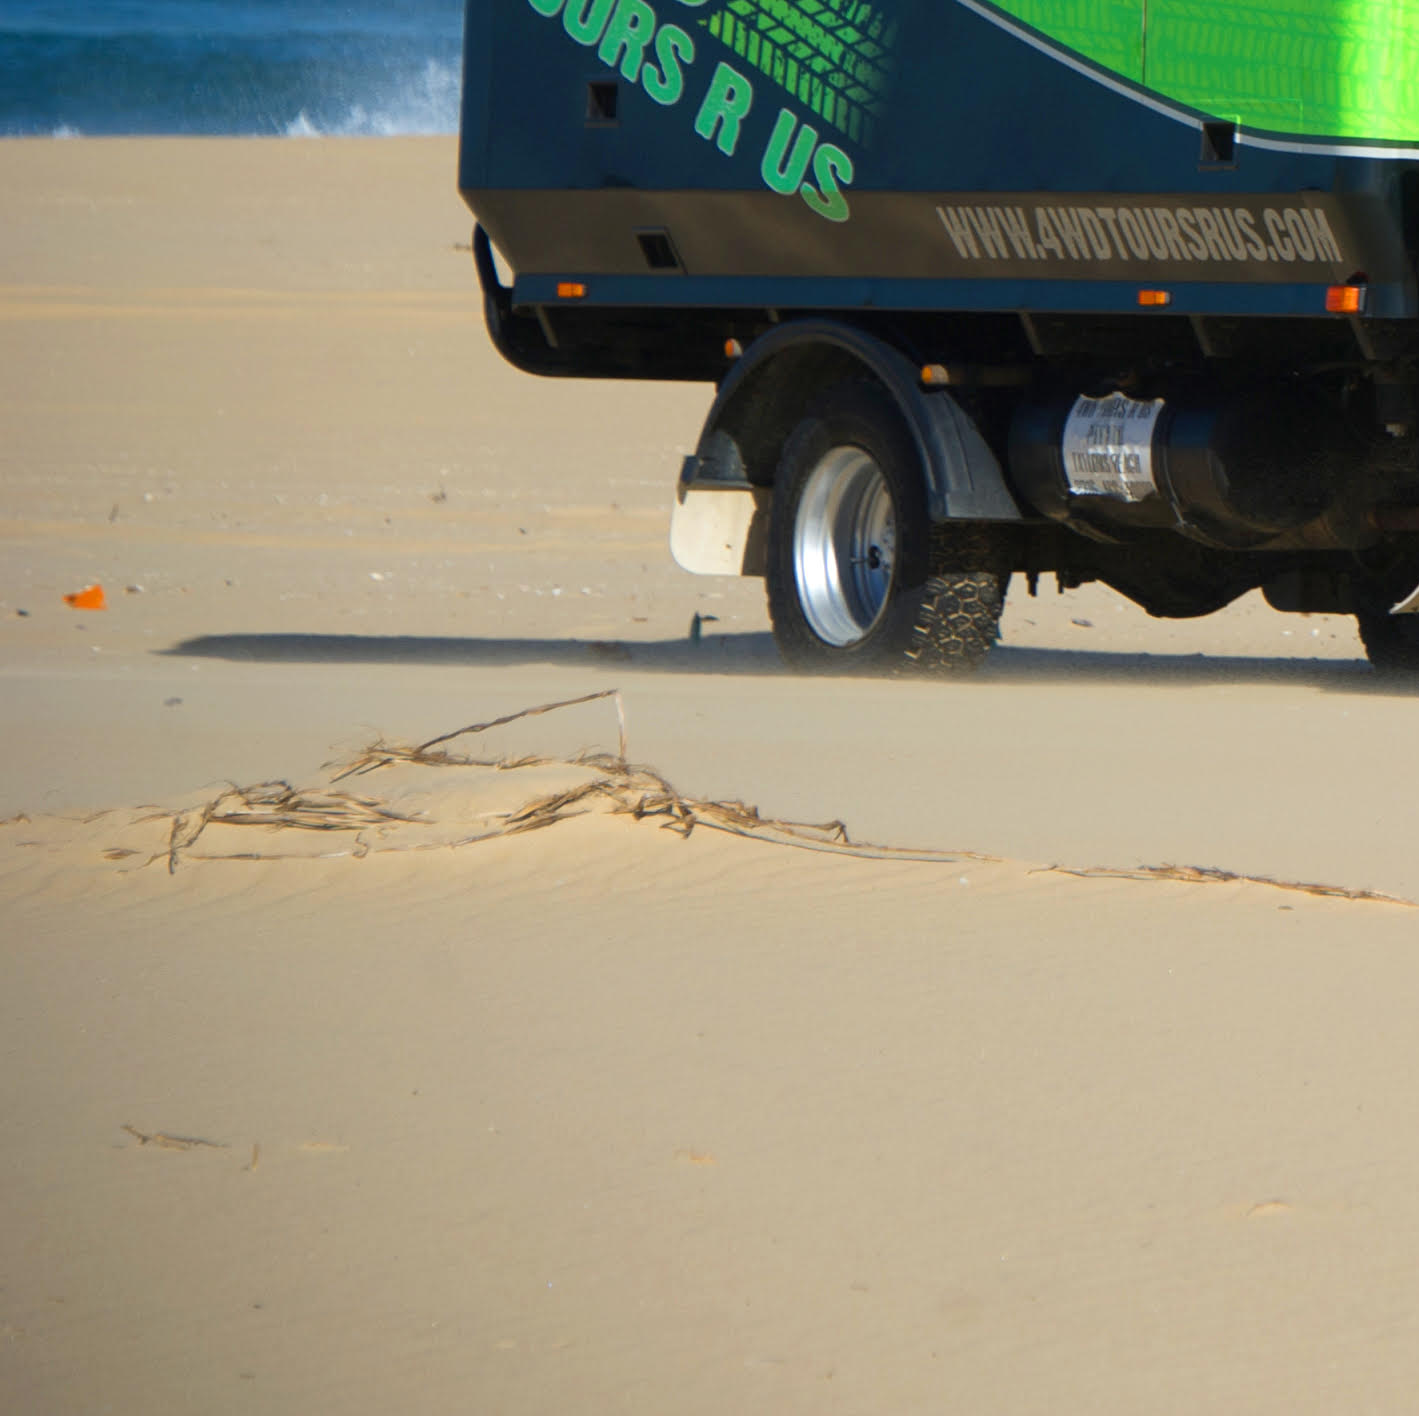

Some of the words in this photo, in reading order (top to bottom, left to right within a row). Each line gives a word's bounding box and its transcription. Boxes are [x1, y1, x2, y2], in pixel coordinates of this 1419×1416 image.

[694, 61, 753, 157] R
[760, 107, 854, 222] US
[935, 205, 1343, 262] WWW.4WDTOURSRUS.COM
